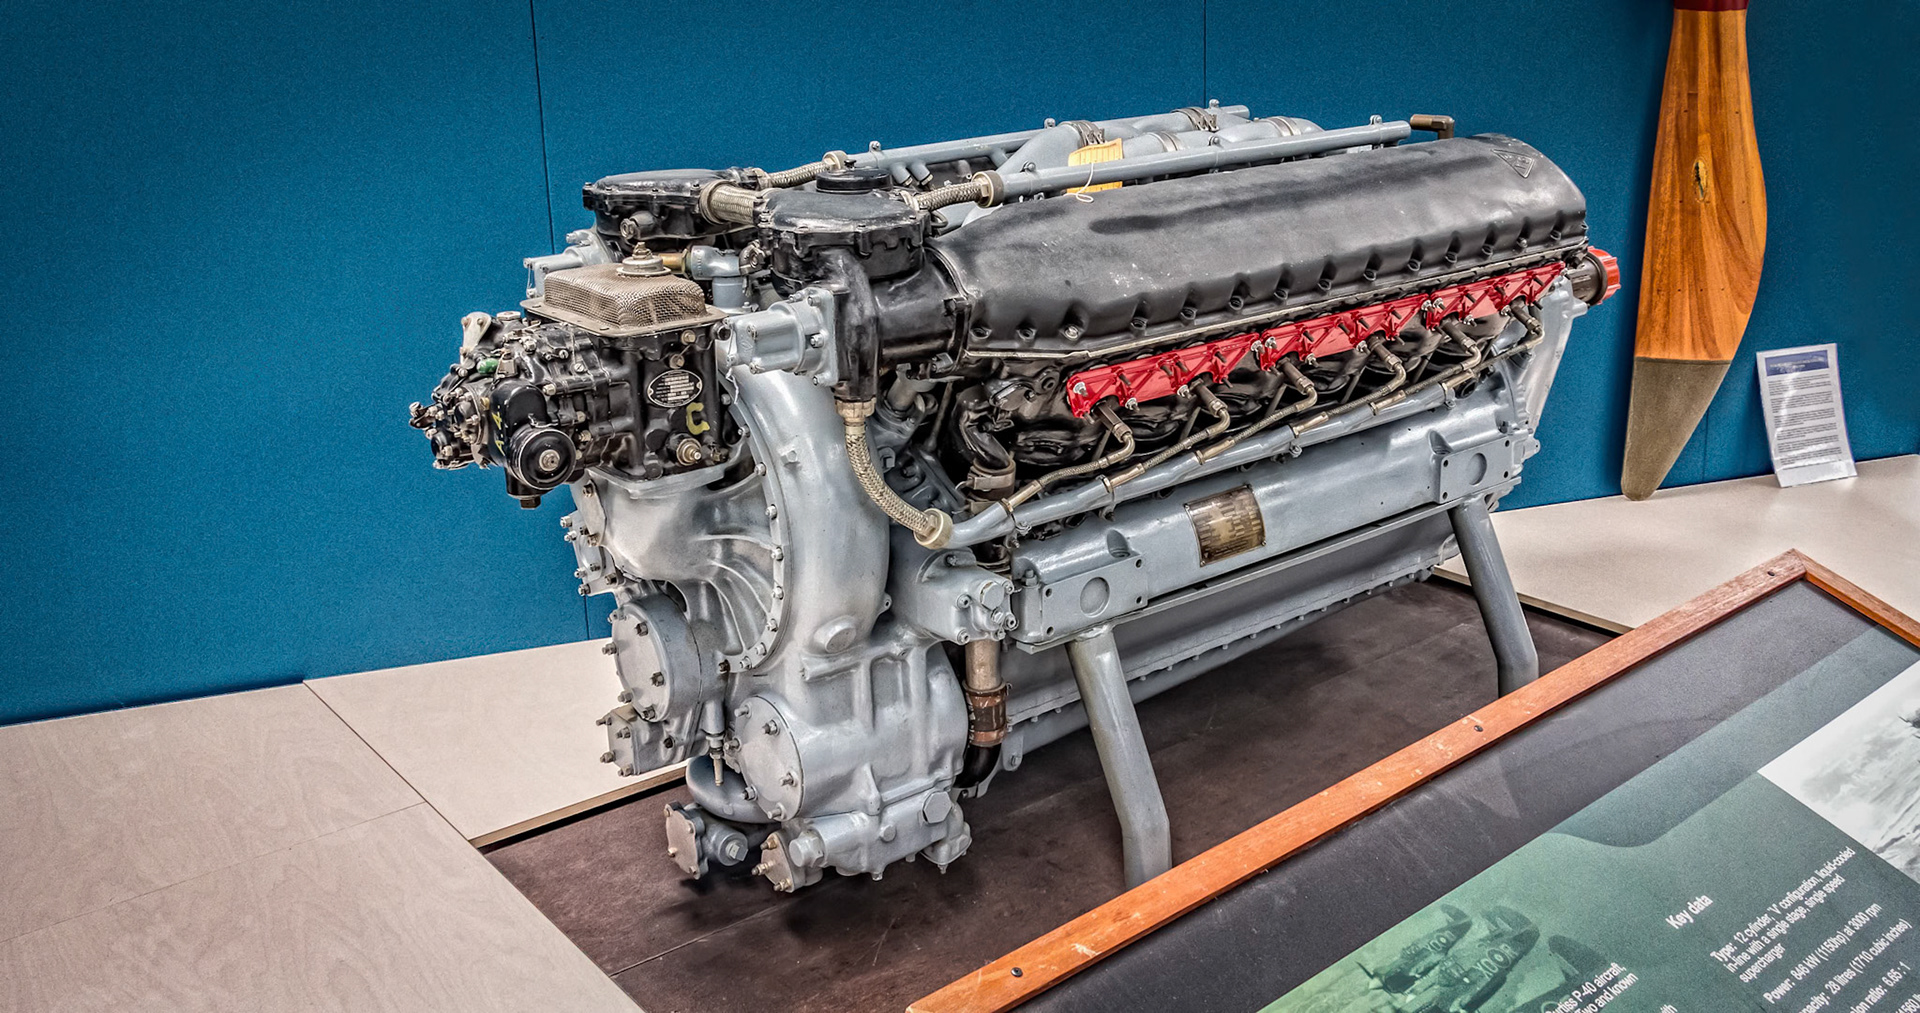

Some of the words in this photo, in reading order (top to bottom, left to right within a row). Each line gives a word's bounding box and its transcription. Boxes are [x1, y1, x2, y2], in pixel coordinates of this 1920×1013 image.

[686, 402, 710, 435] C
[1665, 909, 1694, 930] Key
[1687, 894, 1714, 915] data
[1710, 942, 1738, 963] Type:
[1734, 931, 1748, 944] 12
[1744, 912, 1776, 938] cylinder,
[1778, 874, 1823, 909] configuration,
[1814, 846, 1856, 882] liquid-cooled
[1847, 912, 1871, 931] 3000
[1865, 902, 1883, 918] rpm
[1723, 950, 1751, 973] in-line
[1746, 938, 1766, 958] with
[1761, 935, 1771, 945] a
[1767, 919, 1790, 941] single
[1785, 905, 1811, 925] stage,
[1804, 888, 1827, 909] single
[1823, 873, 1846, 894] speed
[1843, 924, 1856, 937] at
[1739, 941, 1786, 983] supercharger
[1802, 953, 1822, 970] kW
[1814, 930, 1851, 961] (1150hp)
[1824, 980, 1841, 995] 28
[1833, 968, 1857, 987] litres
[1849, 950, 1873, 974] (1710
[1868, 933, 1890, 957] cubic
[1889, 918, 1913, 943] inches)
[1571, 981, 1597, 1003] P-40
[1593, 962, 1628, 988] aircraft,
[1790, 963, 1810, 981] 846
[1864, 984, 1888, 1006] ratio:
[1881, 968, 1903, 987] 6.65
[1594, 989, 1614, 1007] and
[1606, 972, 1639, 996] known
[1762, 978, 1795, 1005] Power:
